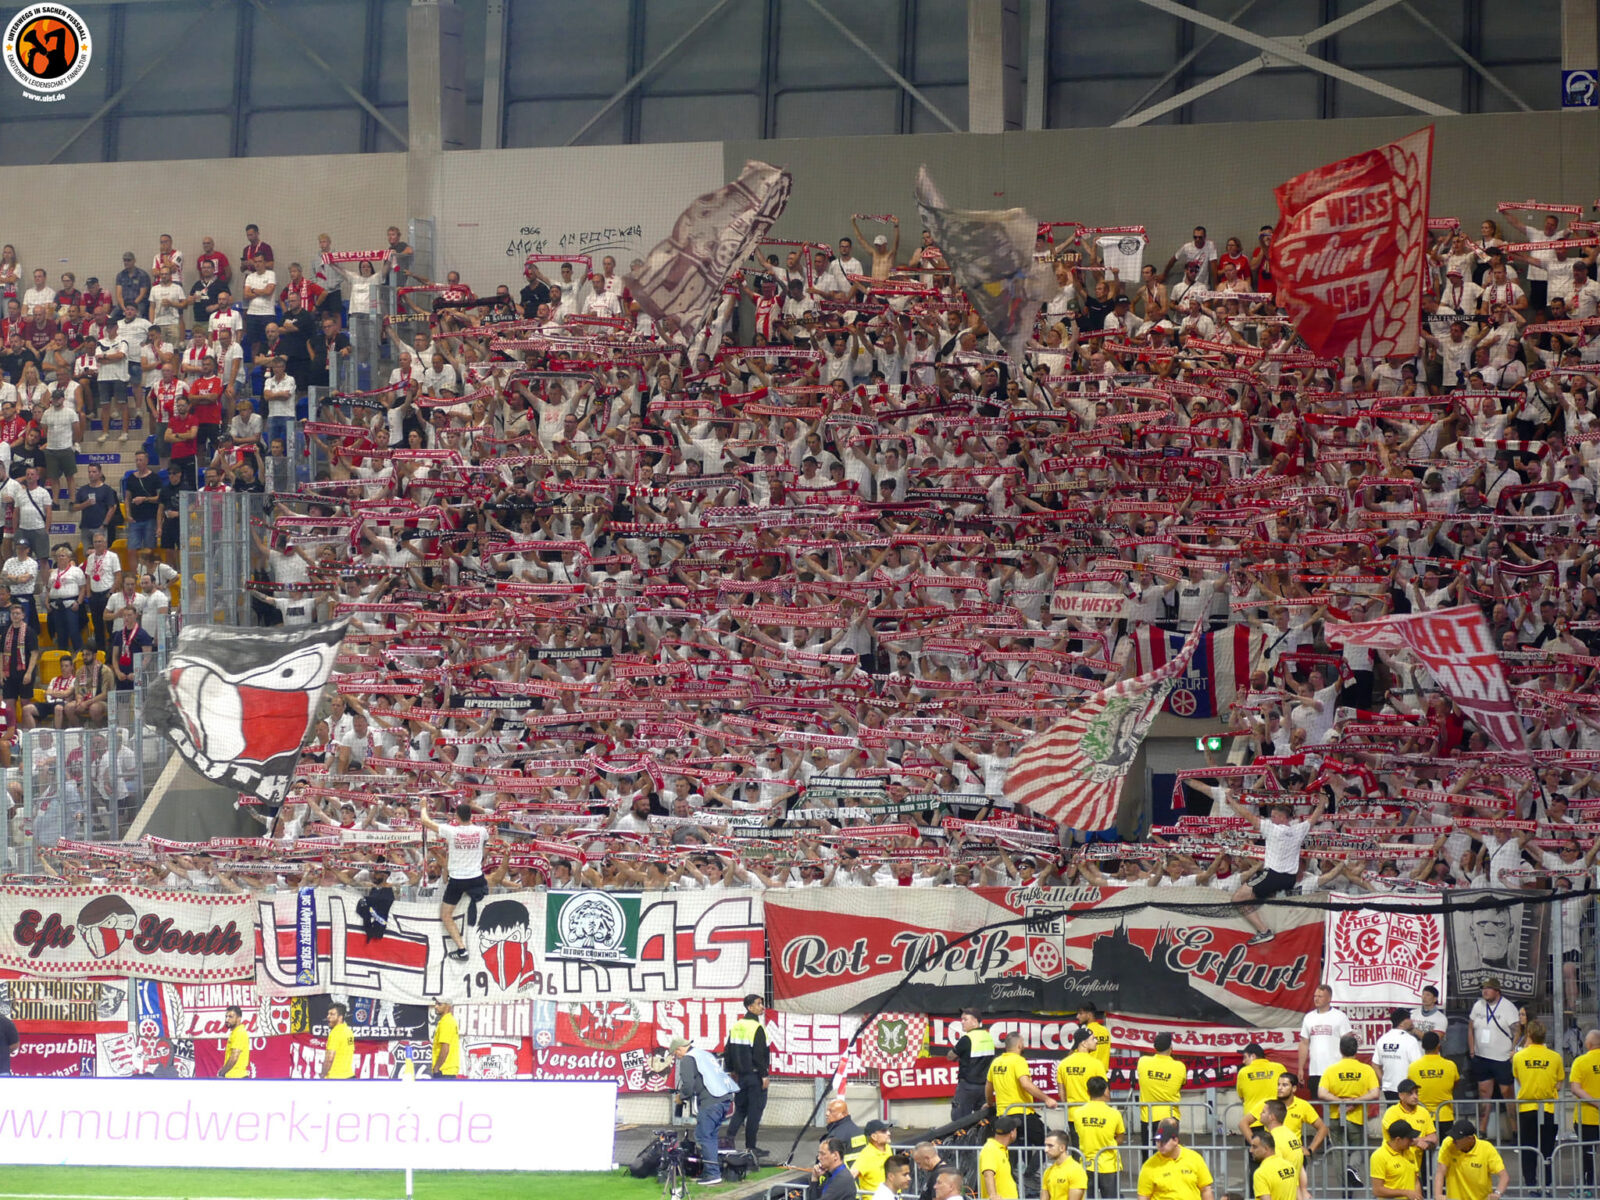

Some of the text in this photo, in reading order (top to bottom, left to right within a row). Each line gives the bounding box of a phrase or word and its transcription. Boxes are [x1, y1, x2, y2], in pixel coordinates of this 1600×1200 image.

[331, 250, 379, 261] ERFURT
[1050, 458, 1101, 468] ERFURT
[1054, 595, 1125, 613] ROT-WEISS
[537, 648, 602, 659] grenzgebiet
[464, 697, 532, 709] grenzgebiet
[640, 724, 680, 734] ROT-WEISS
[1405, 790, 1449, 803] ERFURT
[1027, 921, 1061, 934] RWE
[1353, 914, 1381, 930] HFC
[133, 913, 243, 955] Youth
[1390, 916, 1419, 943] FC RWE
[1165, 926, 1313, 994] Erfurt
[464, 971, 489, 998] 19
[186, 1013, 259, 1036] Lad
[537, 1050, 616, 1069] Versatio
[624, 1052, 645, 1068] FC RWE
[1525, 1059, 1550, 1067] ERJ
[1066, 1066, 1087, 1074] ERJ
[1147, 1069, 1173, 1078] ERJ
[1338, 1071, 1362, 1079] ERJ
[1418, 1069, 1445, 1077] ERJ
[1082, 1117, 1107, 1126] ERJ
